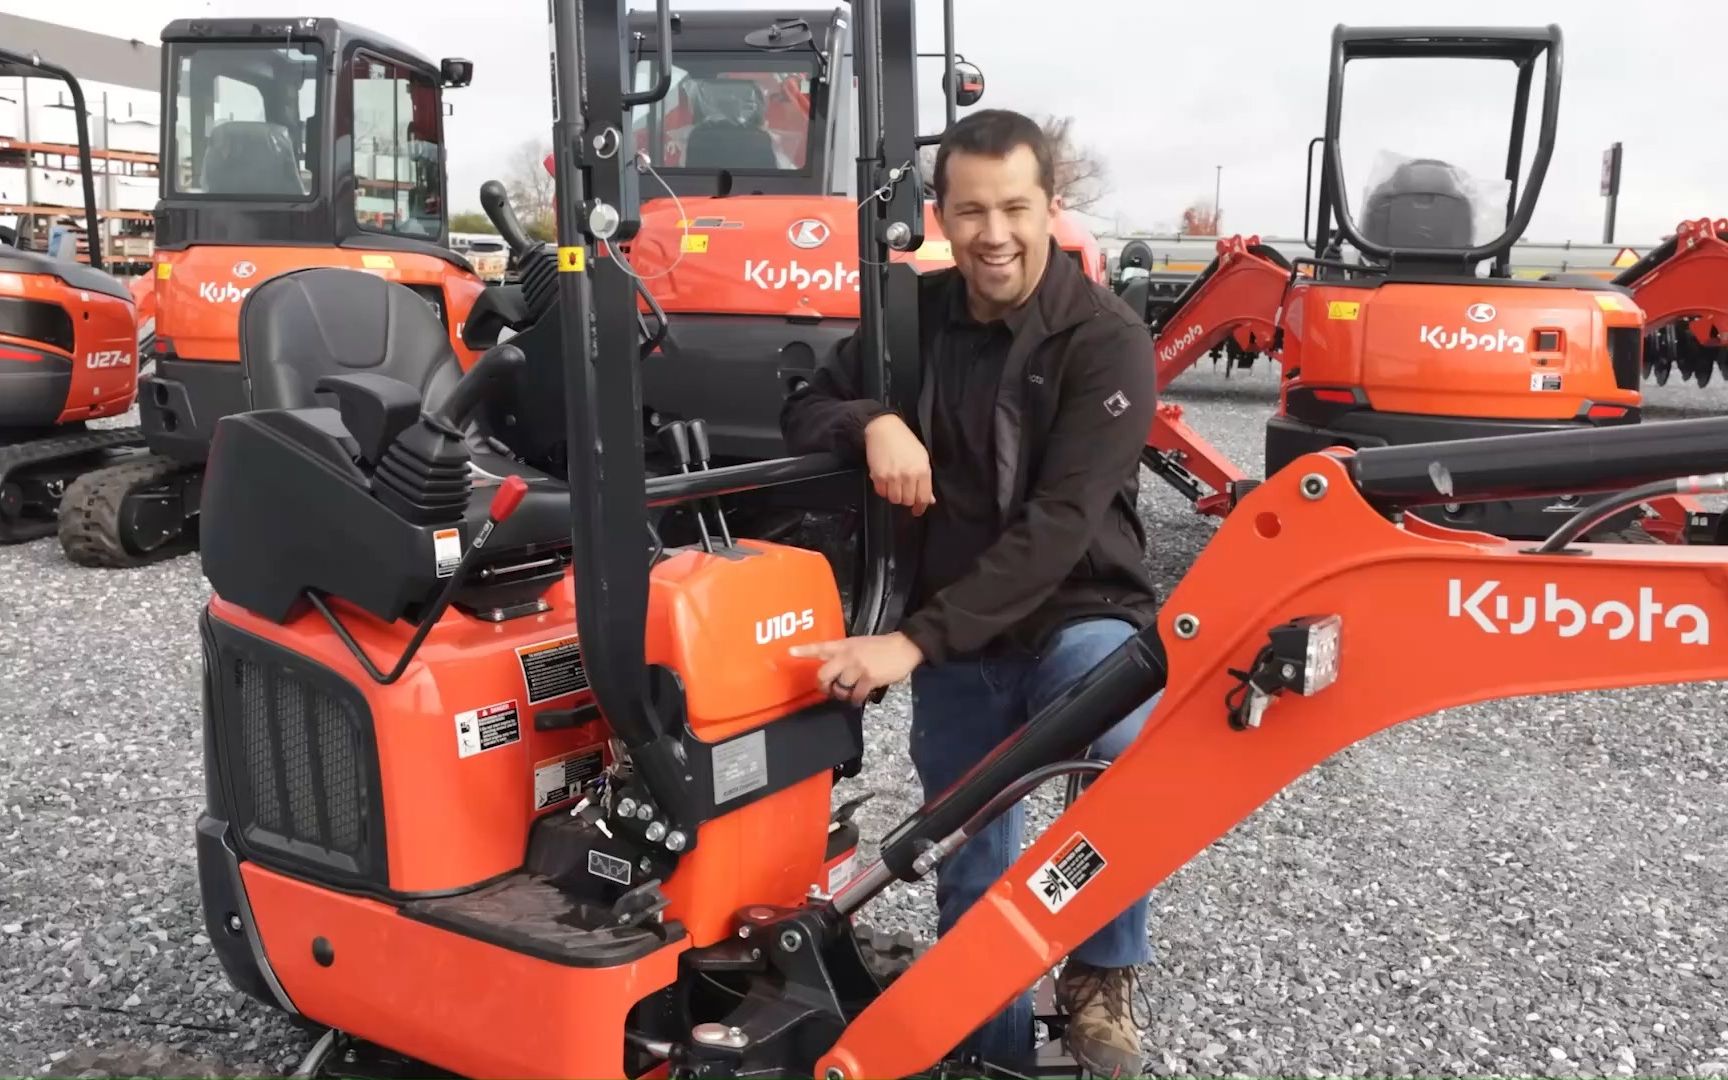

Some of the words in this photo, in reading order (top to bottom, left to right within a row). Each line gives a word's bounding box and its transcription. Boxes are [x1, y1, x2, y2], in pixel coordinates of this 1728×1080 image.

[1160, 324, 1204, 361] Kubota
[1420, 325, 1524, 353] Kubota
[87, 350, 132, 368] U27-4
[756, 608, 814, 645] U10-5
[1448, 579, 1709, 645] Kubota
